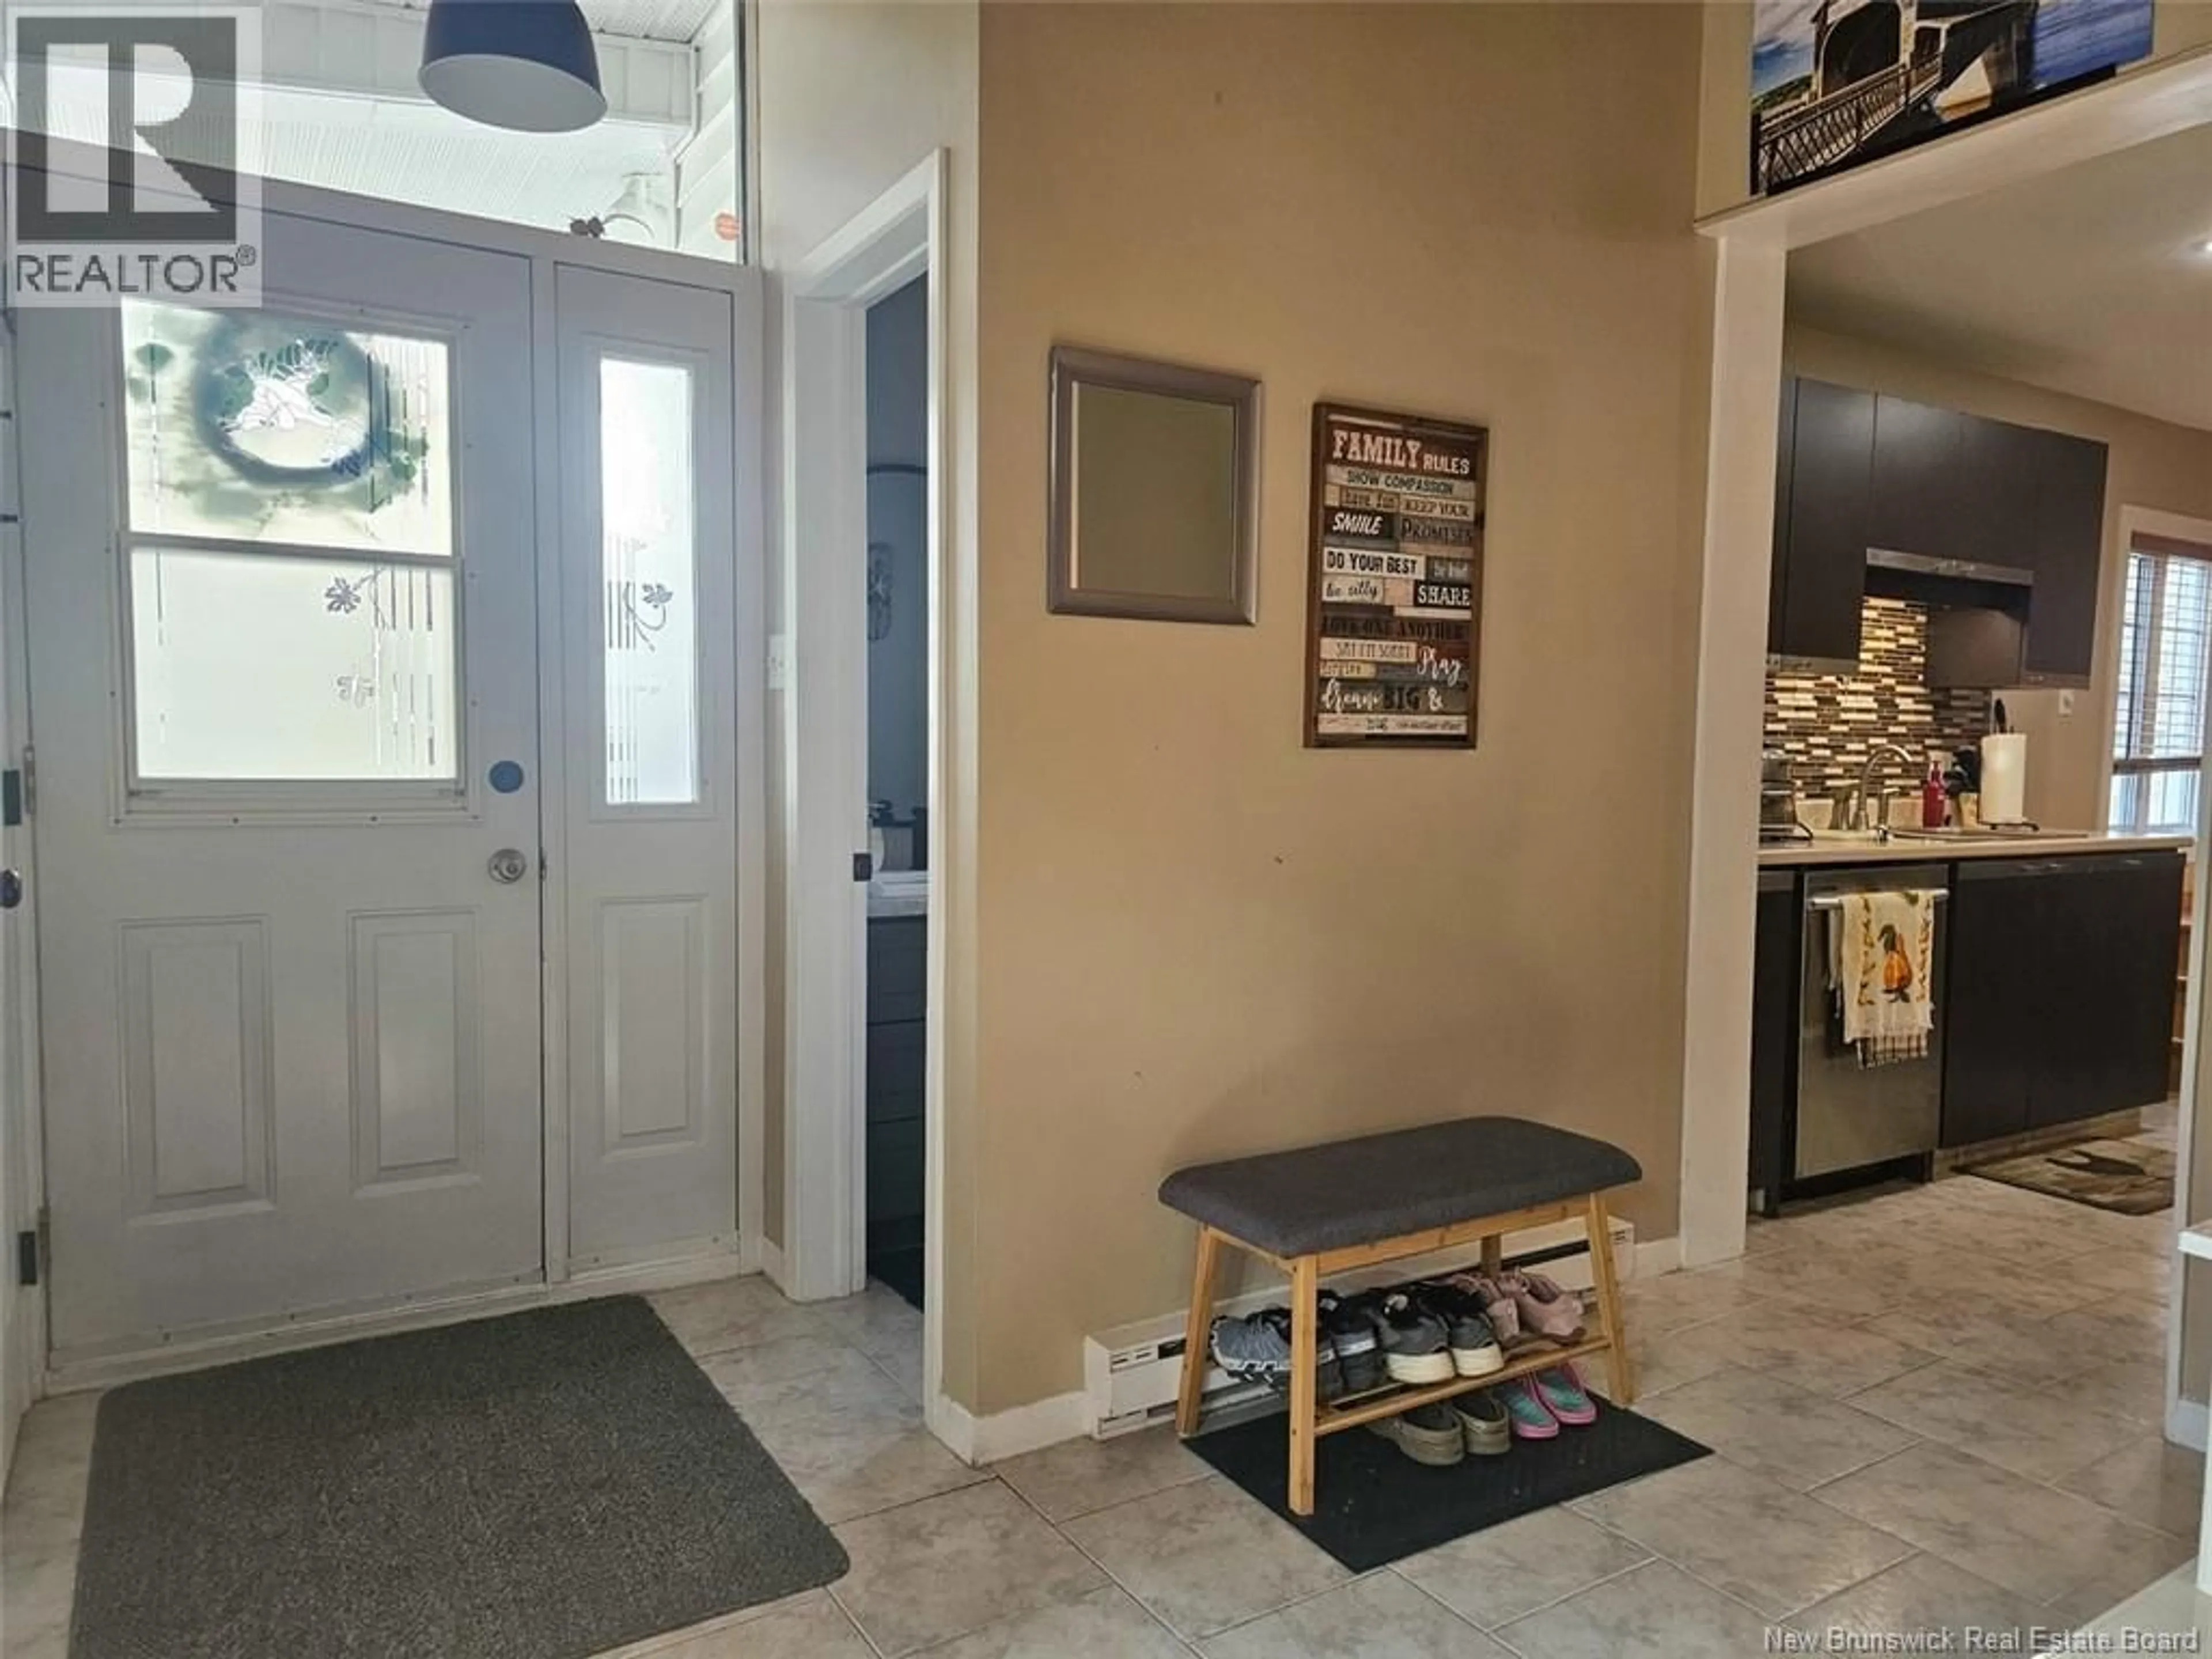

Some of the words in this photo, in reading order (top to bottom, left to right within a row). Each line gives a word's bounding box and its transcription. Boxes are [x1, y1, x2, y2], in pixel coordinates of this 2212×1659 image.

[1332, 430, 1422, 468] FAMILY
[1423, 453, 1470, 475] RULES
[1347, 470, 1380, 486] SHOW
[1332, 512, 1382, 535] SMILE
[1327, 551, 1344, 569] DO
[1350, 553, 1383, 573] YOUR
[1387, 556, 1418, 574] BEST
[1348, 580, 1378, 598] silly
[1418, 585, 1471, 606] SHARE
[1384, 687, 1421, 710] BIG
[1427, 687, 1444, 711] &
